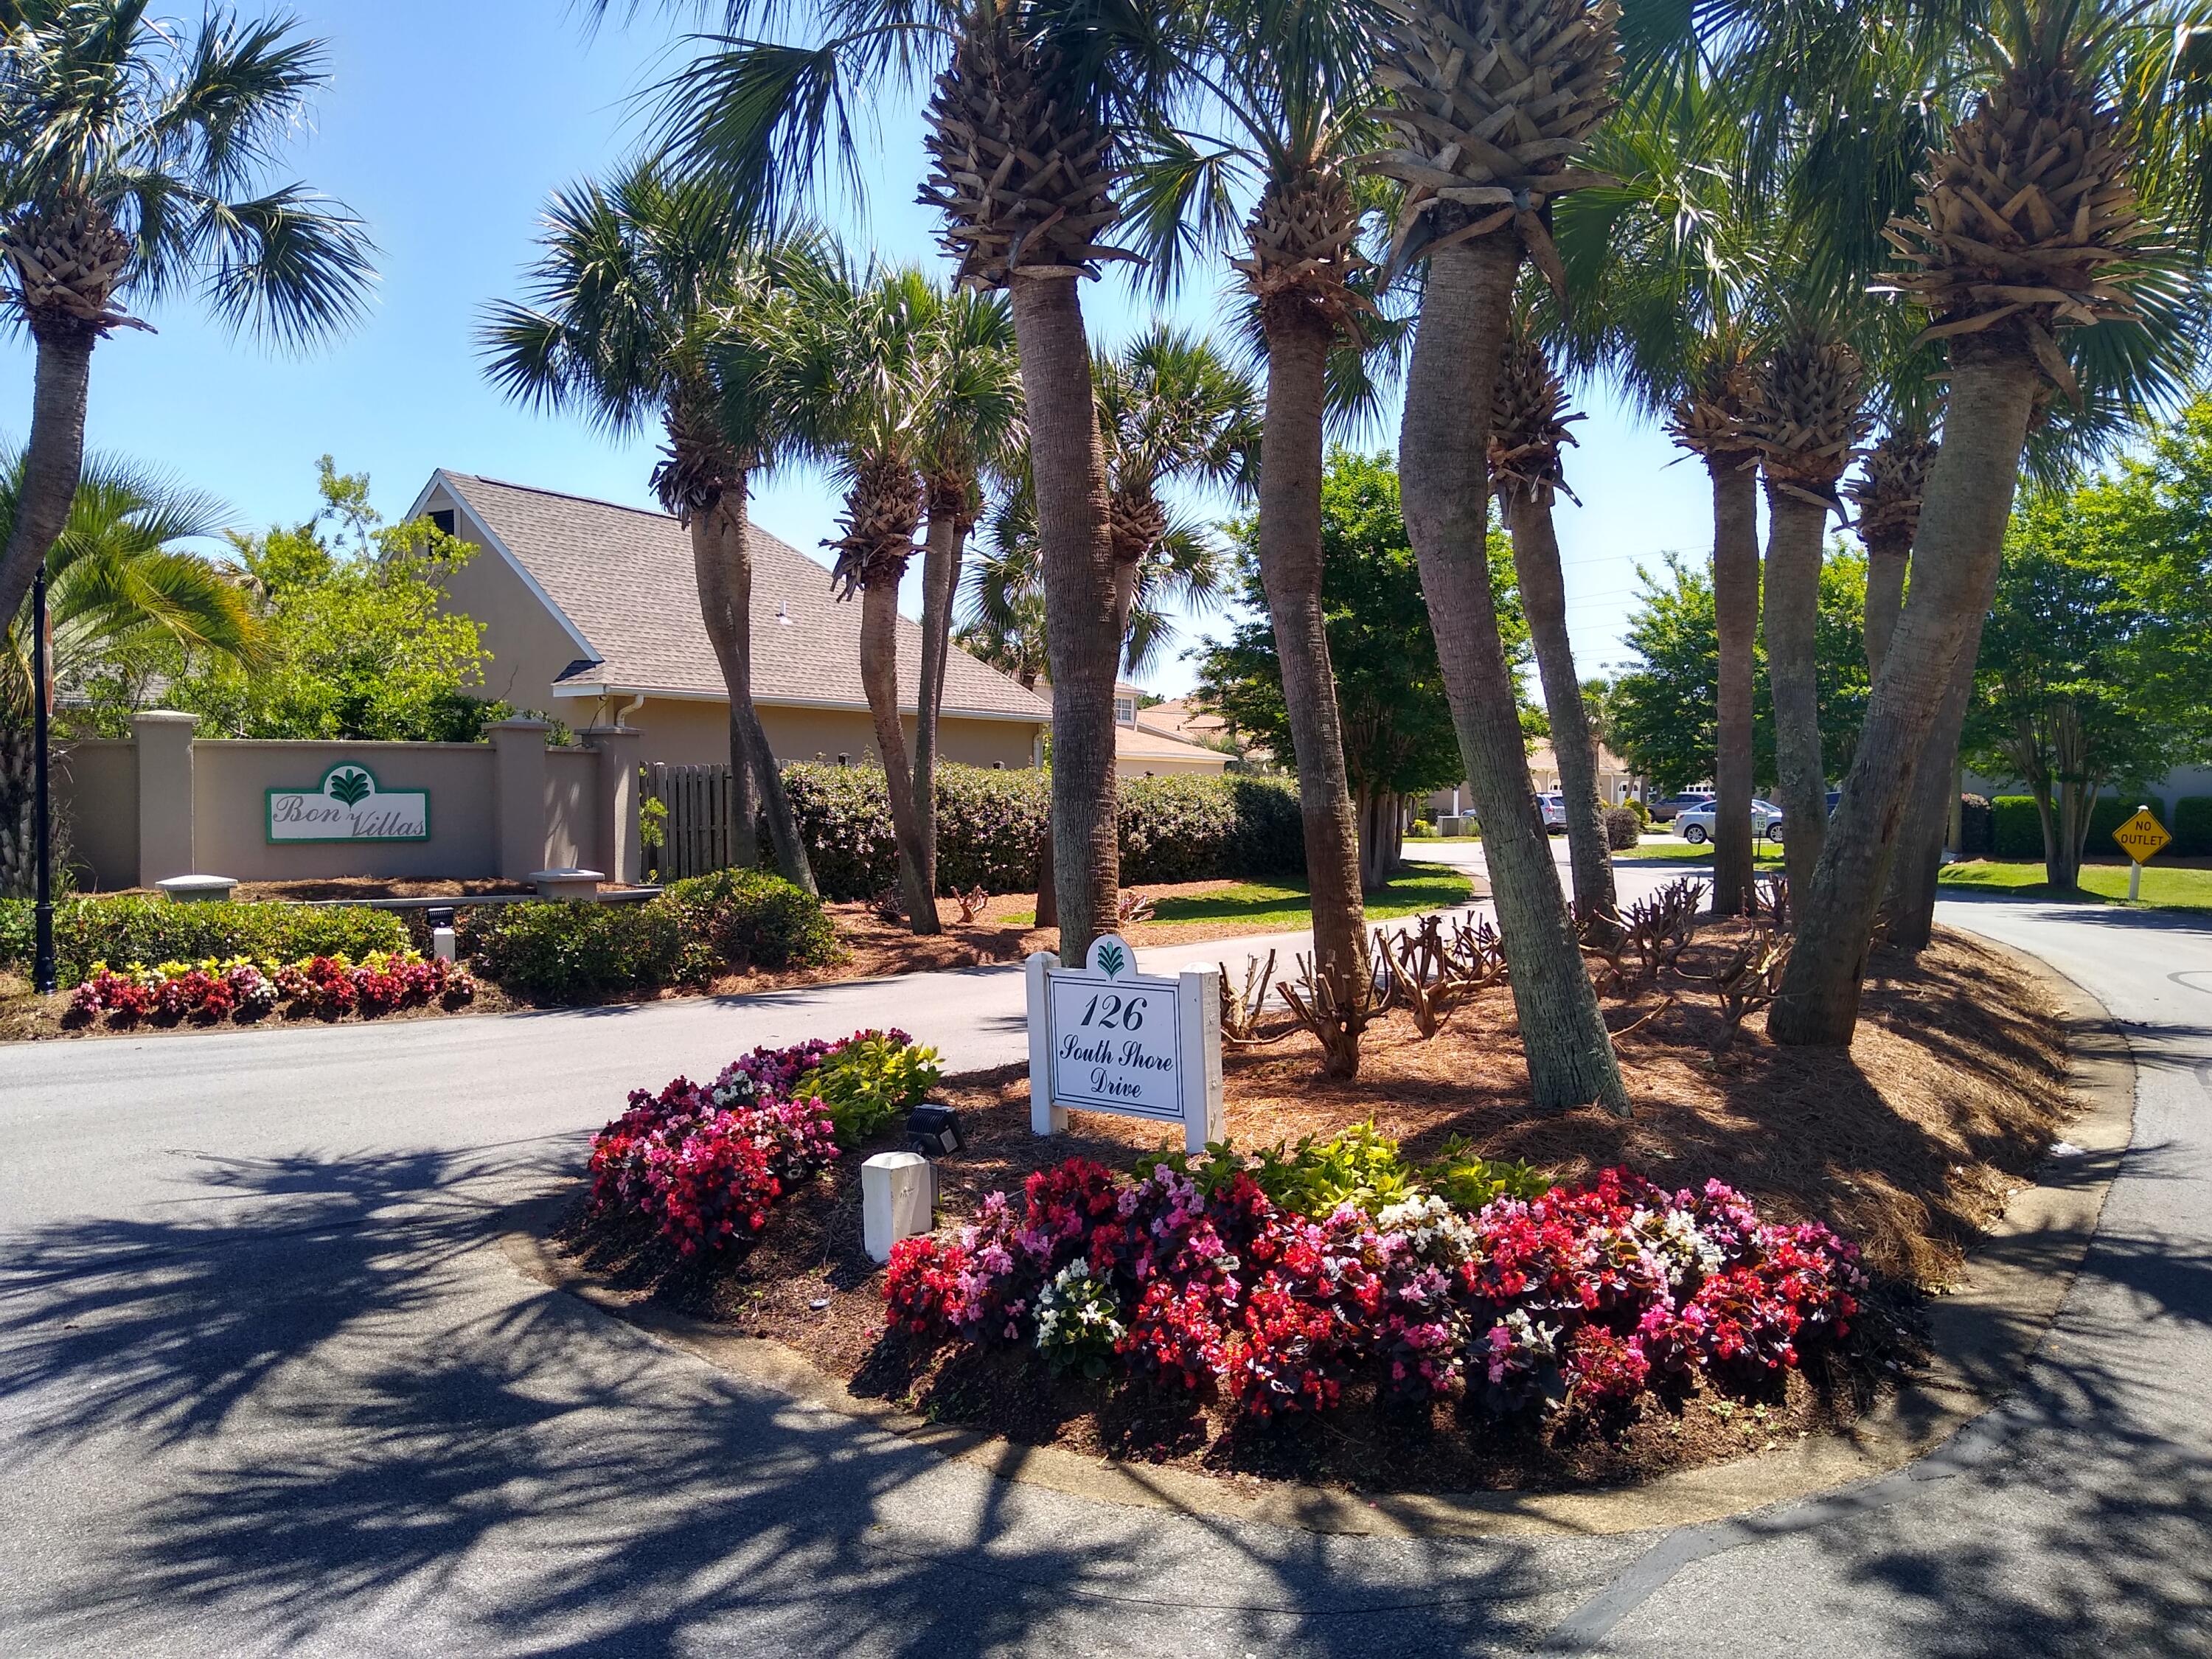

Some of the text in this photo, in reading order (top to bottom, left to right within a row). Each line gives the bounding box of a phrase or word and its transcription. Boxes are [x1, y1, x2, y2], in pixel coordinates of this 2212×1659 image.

[274, 796, 424, 836] Bon Villas
[2135, 821, 2152, 831] NO
[2121, 834, 2163, 846] OUTLET
[1080, 993, 1147, 1031] 126
[1060, 1034, 1174, 1071] South Shore
[1090, 1067, 1142, 1098] Drive
